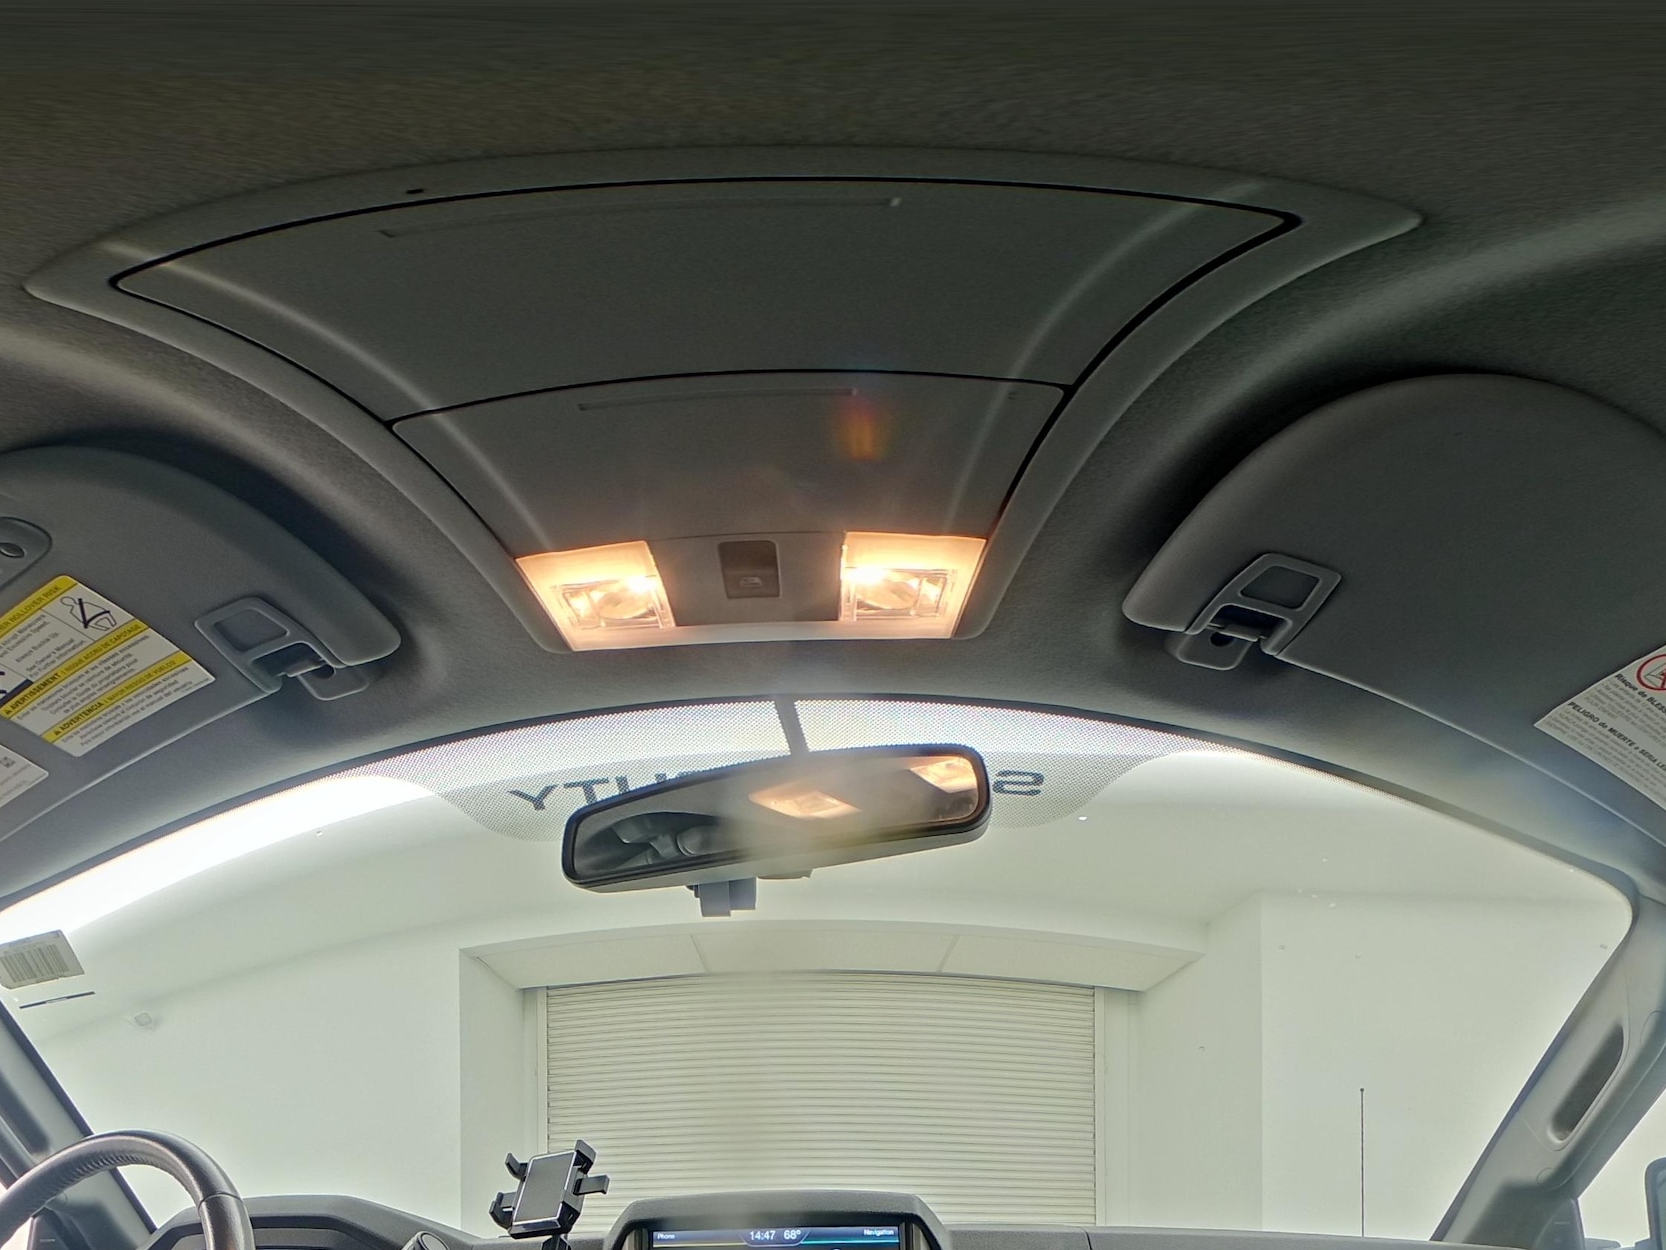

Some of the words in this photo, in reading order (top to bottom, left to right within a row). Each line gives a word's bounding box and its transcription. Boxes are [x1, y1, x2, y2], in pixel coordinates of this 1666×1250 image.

[7, 596, 45, 622] ROLLOVER
[41, 584, 62, 598] RISK
[8, 672, 62, 710] AVERTISSEMENT
[99, 641, 111, 649] DE
[107, 623, 142, 644] CAPOTAGE
[14, 649, 35, 663] Always
[25, 663, 37, 672] See
[53, 637, 75, 652] Manual
[1612, 672, 1641, 692] Risque
[1636, 689, 1649, 698] de
[58, 700, 105, 731] ADVERTENCIA
[1565, 701, 1601, 723] PELIGRO
[1596, 720, 1611, 729] de
[1605, 727, 1636, 747] MUERTE
[1637, 748, 1659, 763] SERIA
[749, 1230, 776, 1241] 14:47
[783, 1229, 802, 1241] 68°
[863, 1228, 894, 1237] Navigation
